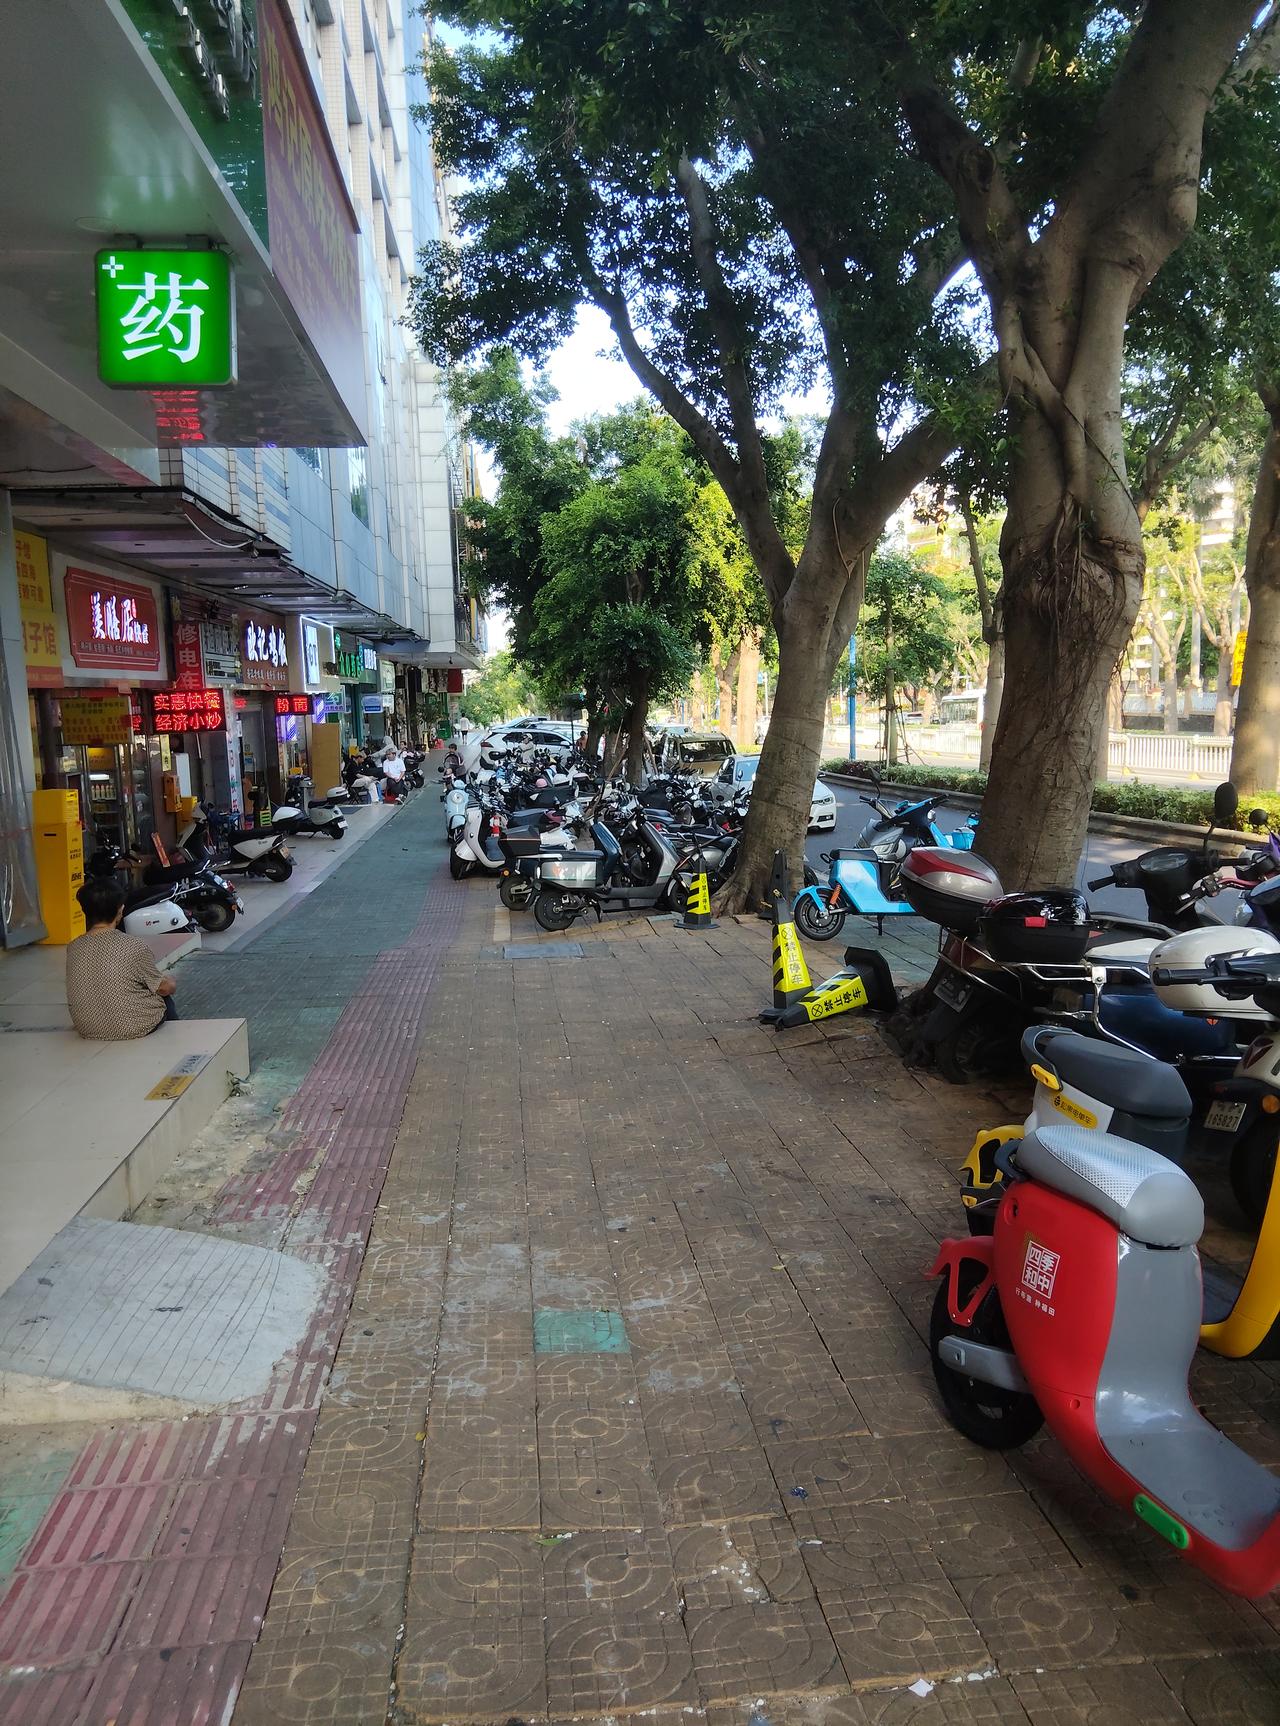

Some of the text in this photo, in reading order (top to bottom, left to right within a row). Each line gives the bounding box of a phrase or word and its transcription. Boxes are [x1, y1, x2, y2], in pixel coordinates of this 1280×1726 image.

[117, 272, 209, 364] 药
[176, 623, 201, 689] 修电车
[154, 691, 221, 711] 实惠快餐
[277, 697, 308, 712] 粉面
[155, 713, 222, 731] 经济小炒
[785, 941, 804, 985] 禁止停车
[824, 989, 862, 1013] 禁止停车
